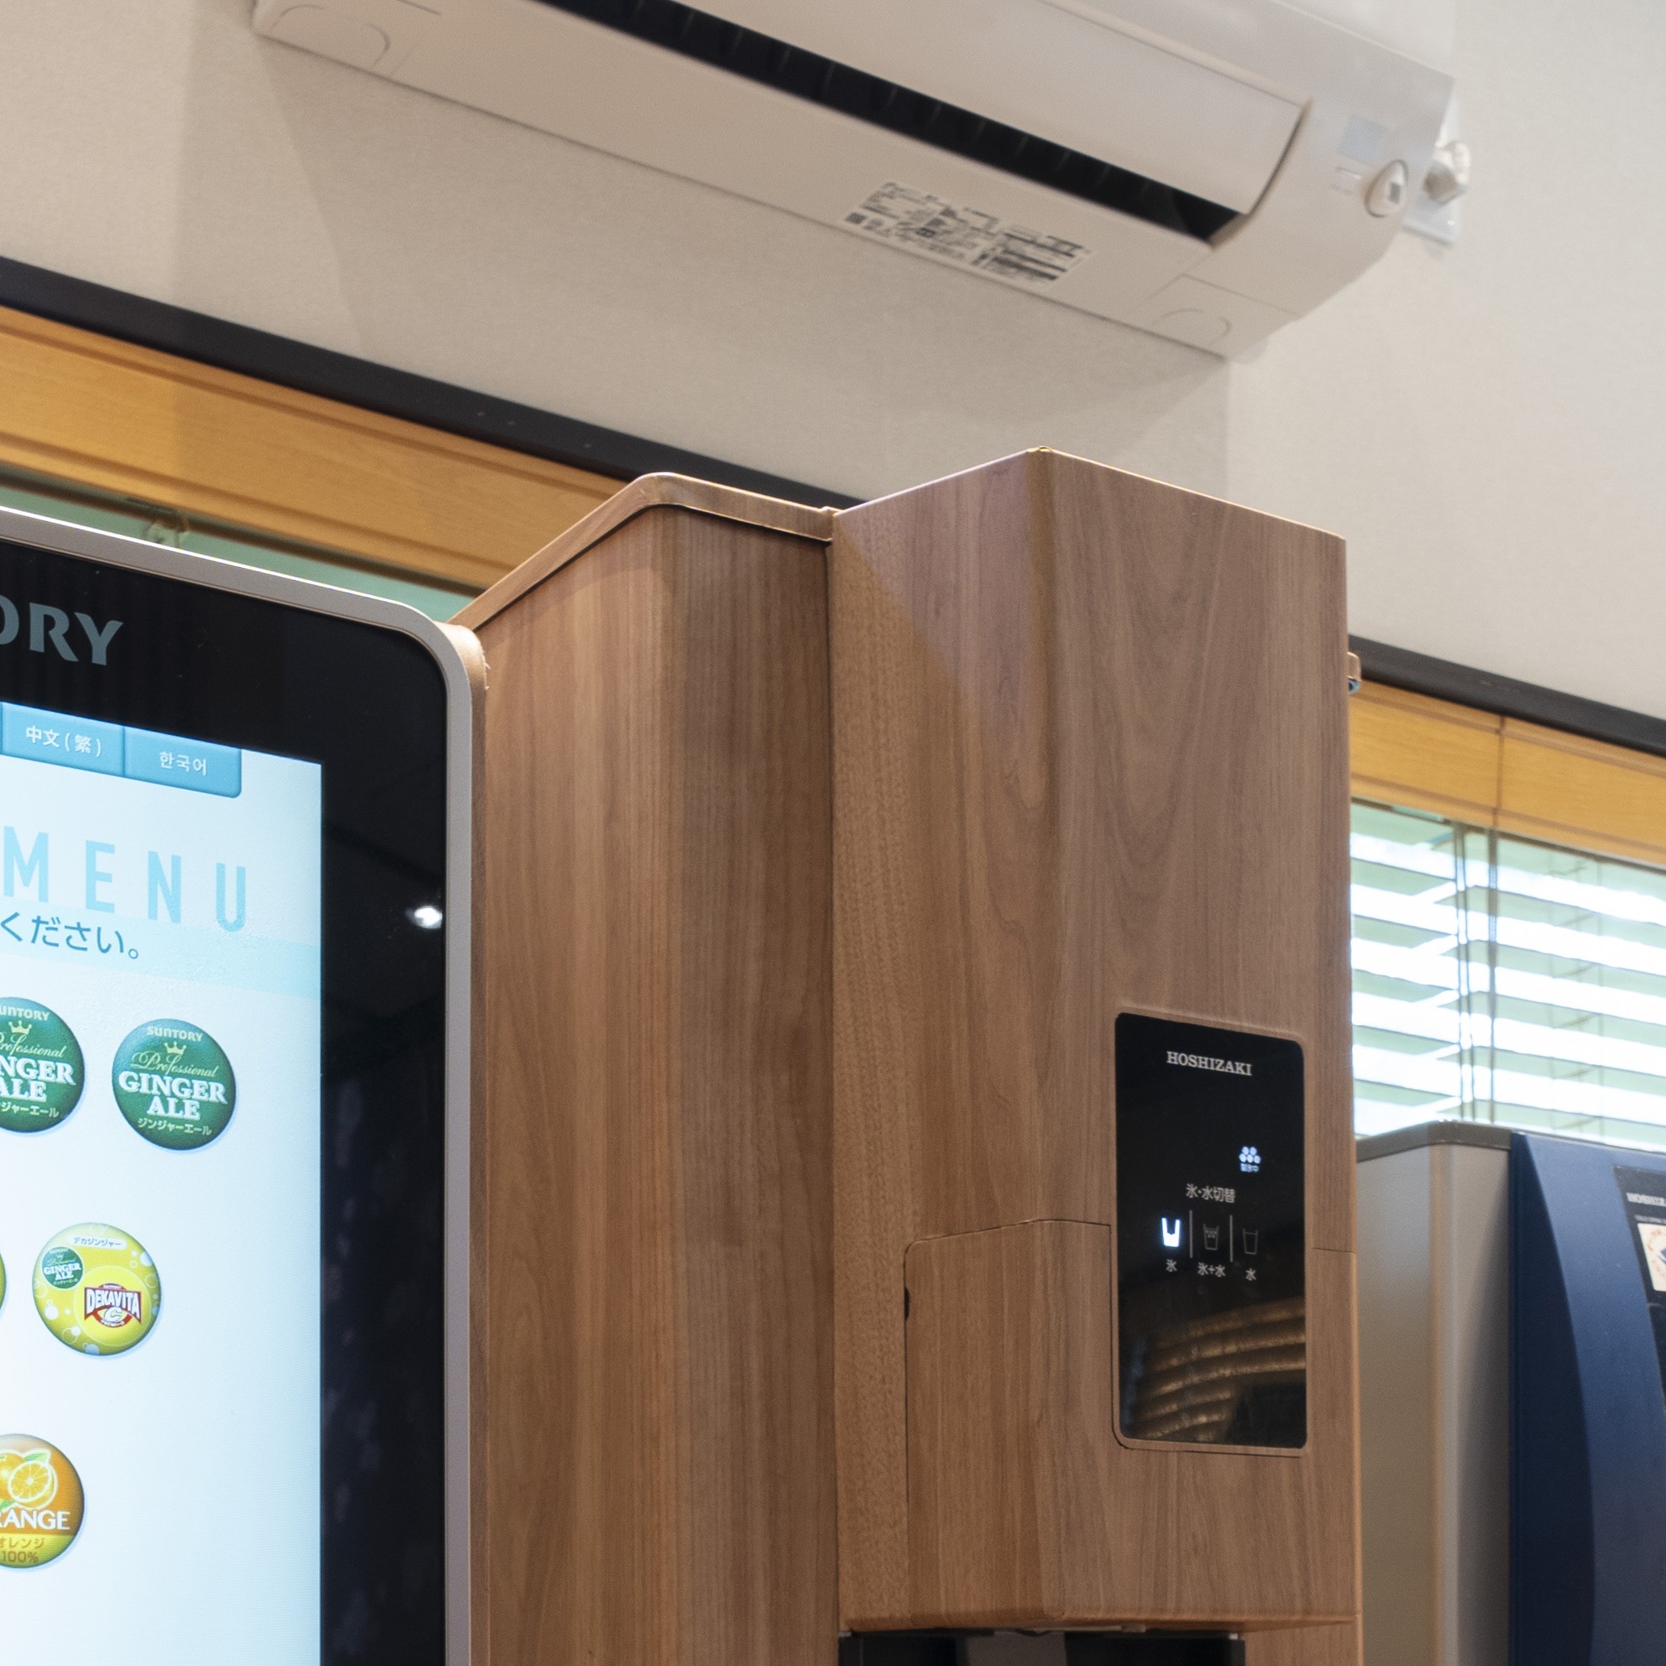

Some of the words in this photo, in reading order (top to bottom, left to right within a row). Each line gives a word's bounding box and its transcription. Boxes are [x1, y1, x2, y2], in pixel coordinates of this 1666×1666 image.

[159, 749, 208, 776] 한국어
[3, 826, 247, 933] MENU
[146, 1025, 203, 1042] SUNTORY
[130, 1050, 219, 1078] Professional
[1166, 1051, 1252, 1076] HOSHIZAKI
[118, 1070, 228, 1105] GINGER
[146, 1096, 201, 1121] ALE
[137, 1117, 212, 1136] ジンジャーエール
[86, 1288, 140, 1319] DEKAVITA
[2, 1550, 39, 1563] 100%
